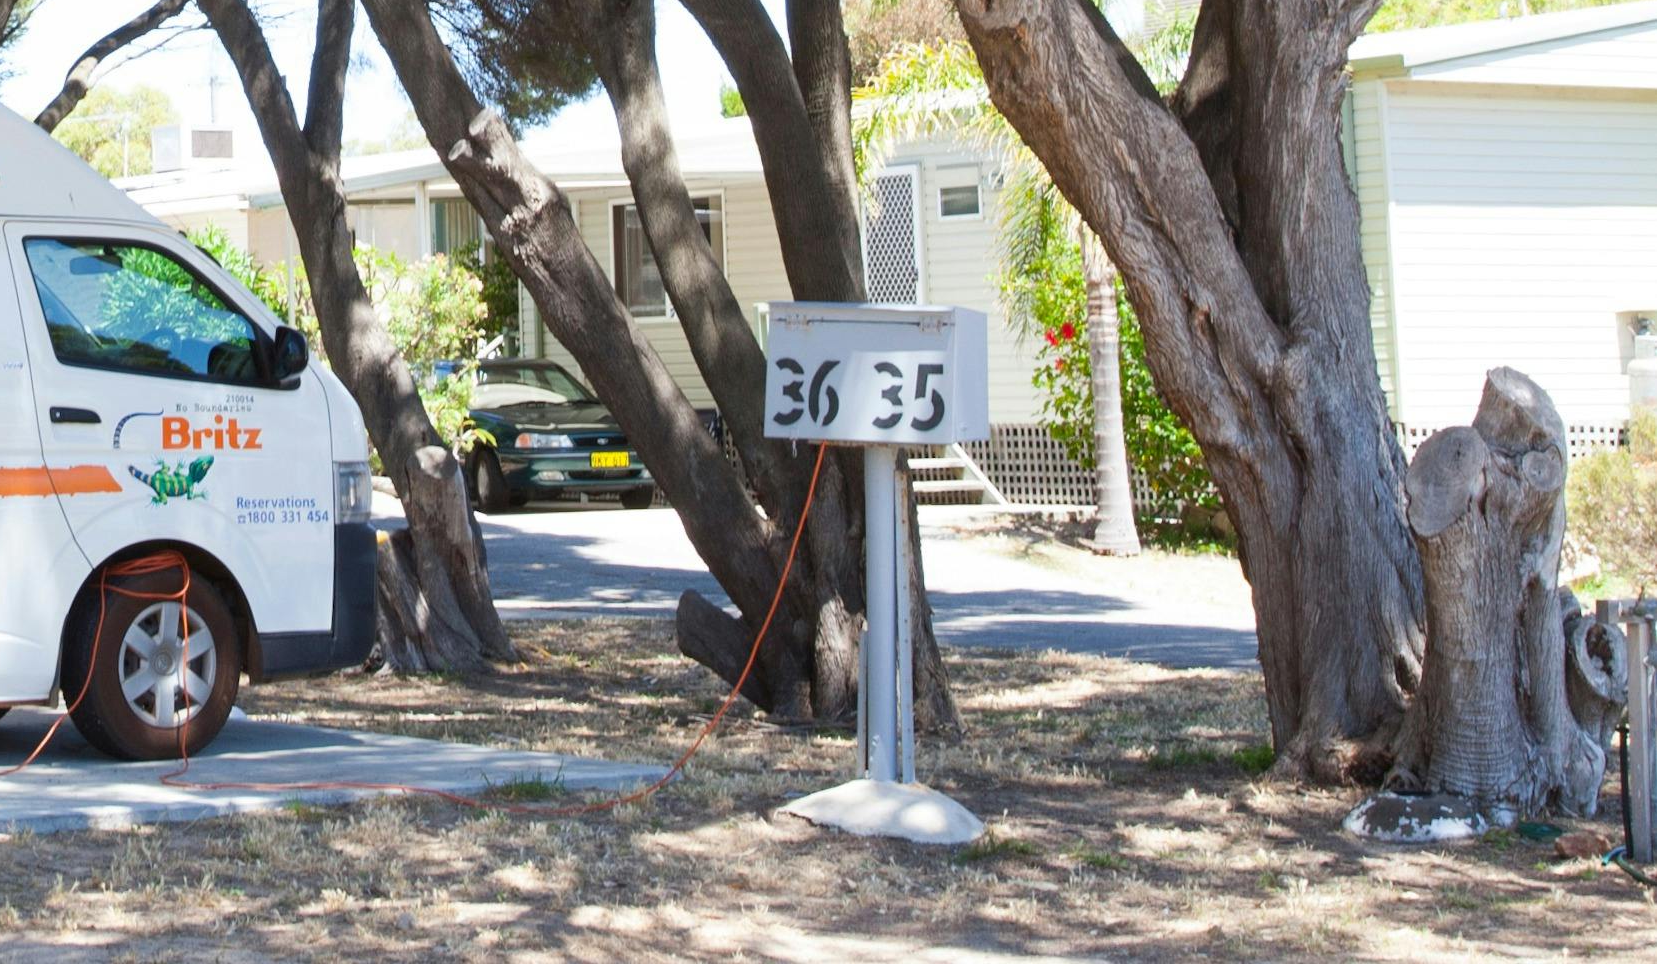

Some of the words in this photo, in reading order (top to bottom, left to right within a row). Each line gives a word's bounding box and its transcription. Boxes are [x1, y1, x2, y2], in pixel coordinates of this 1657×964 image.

[773, 357, 841, 426] 36
[872, 361, 945, 432] 35
[175, 402, 188, 413] No
[194, 402, 252, 413] Boundaries
[161, 414, 263, 450] Britz
[236, 495, 316, 509] Reservations
[247, 510, 275, 523] 1800
[281, 510, 301, 523] 331
[307, 509, 329, 522] 454
